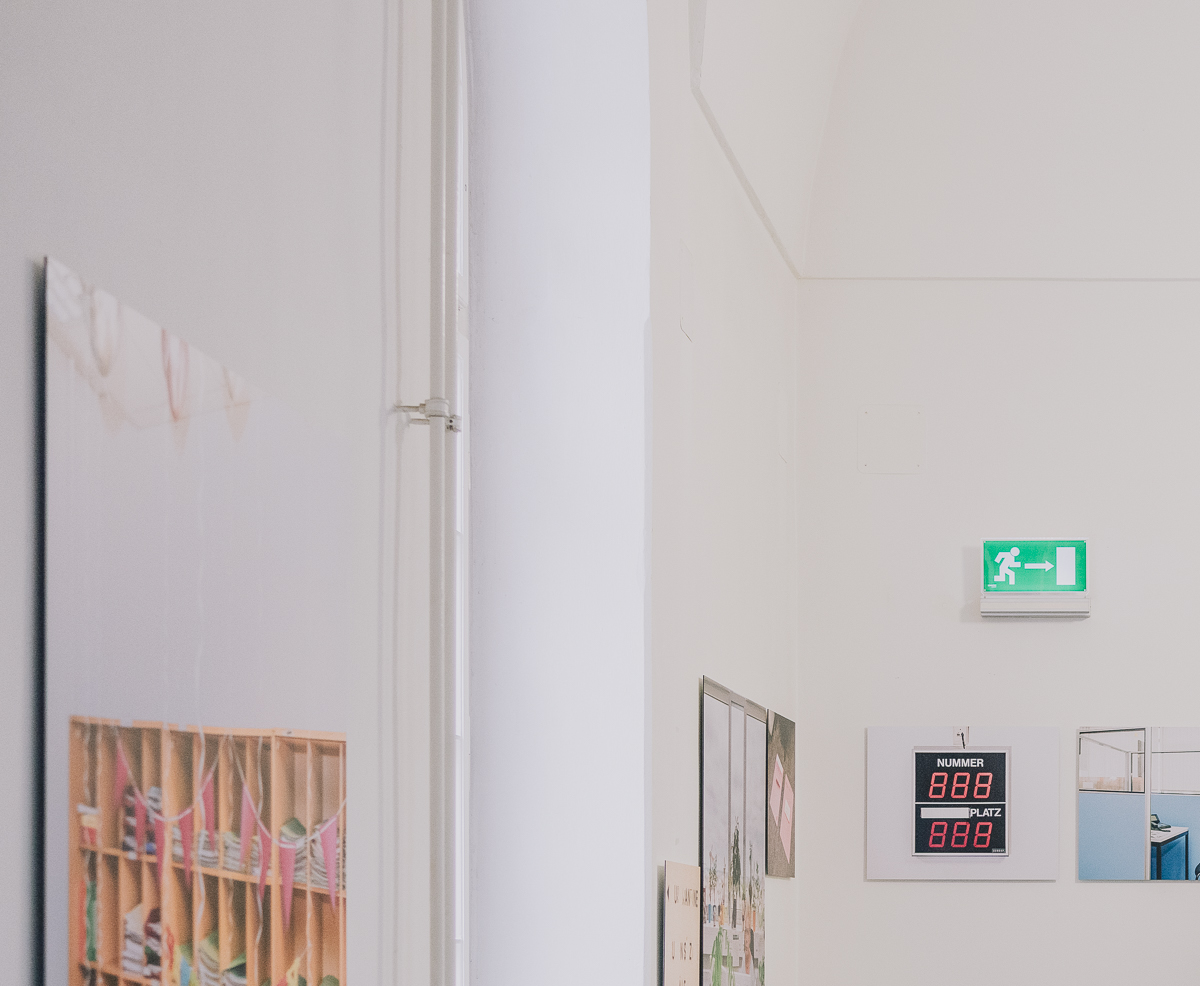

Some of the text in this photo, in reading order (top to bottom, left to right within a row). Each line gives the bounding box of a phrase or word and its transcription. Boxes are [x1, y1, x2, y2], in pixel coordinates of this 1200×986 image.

[937, 758, 984, 767] NUMMER
[928, 772, 993, 798] 888
[970, 808, 1001, 817] PLATZ
[928, 822, 993, 848] 888
